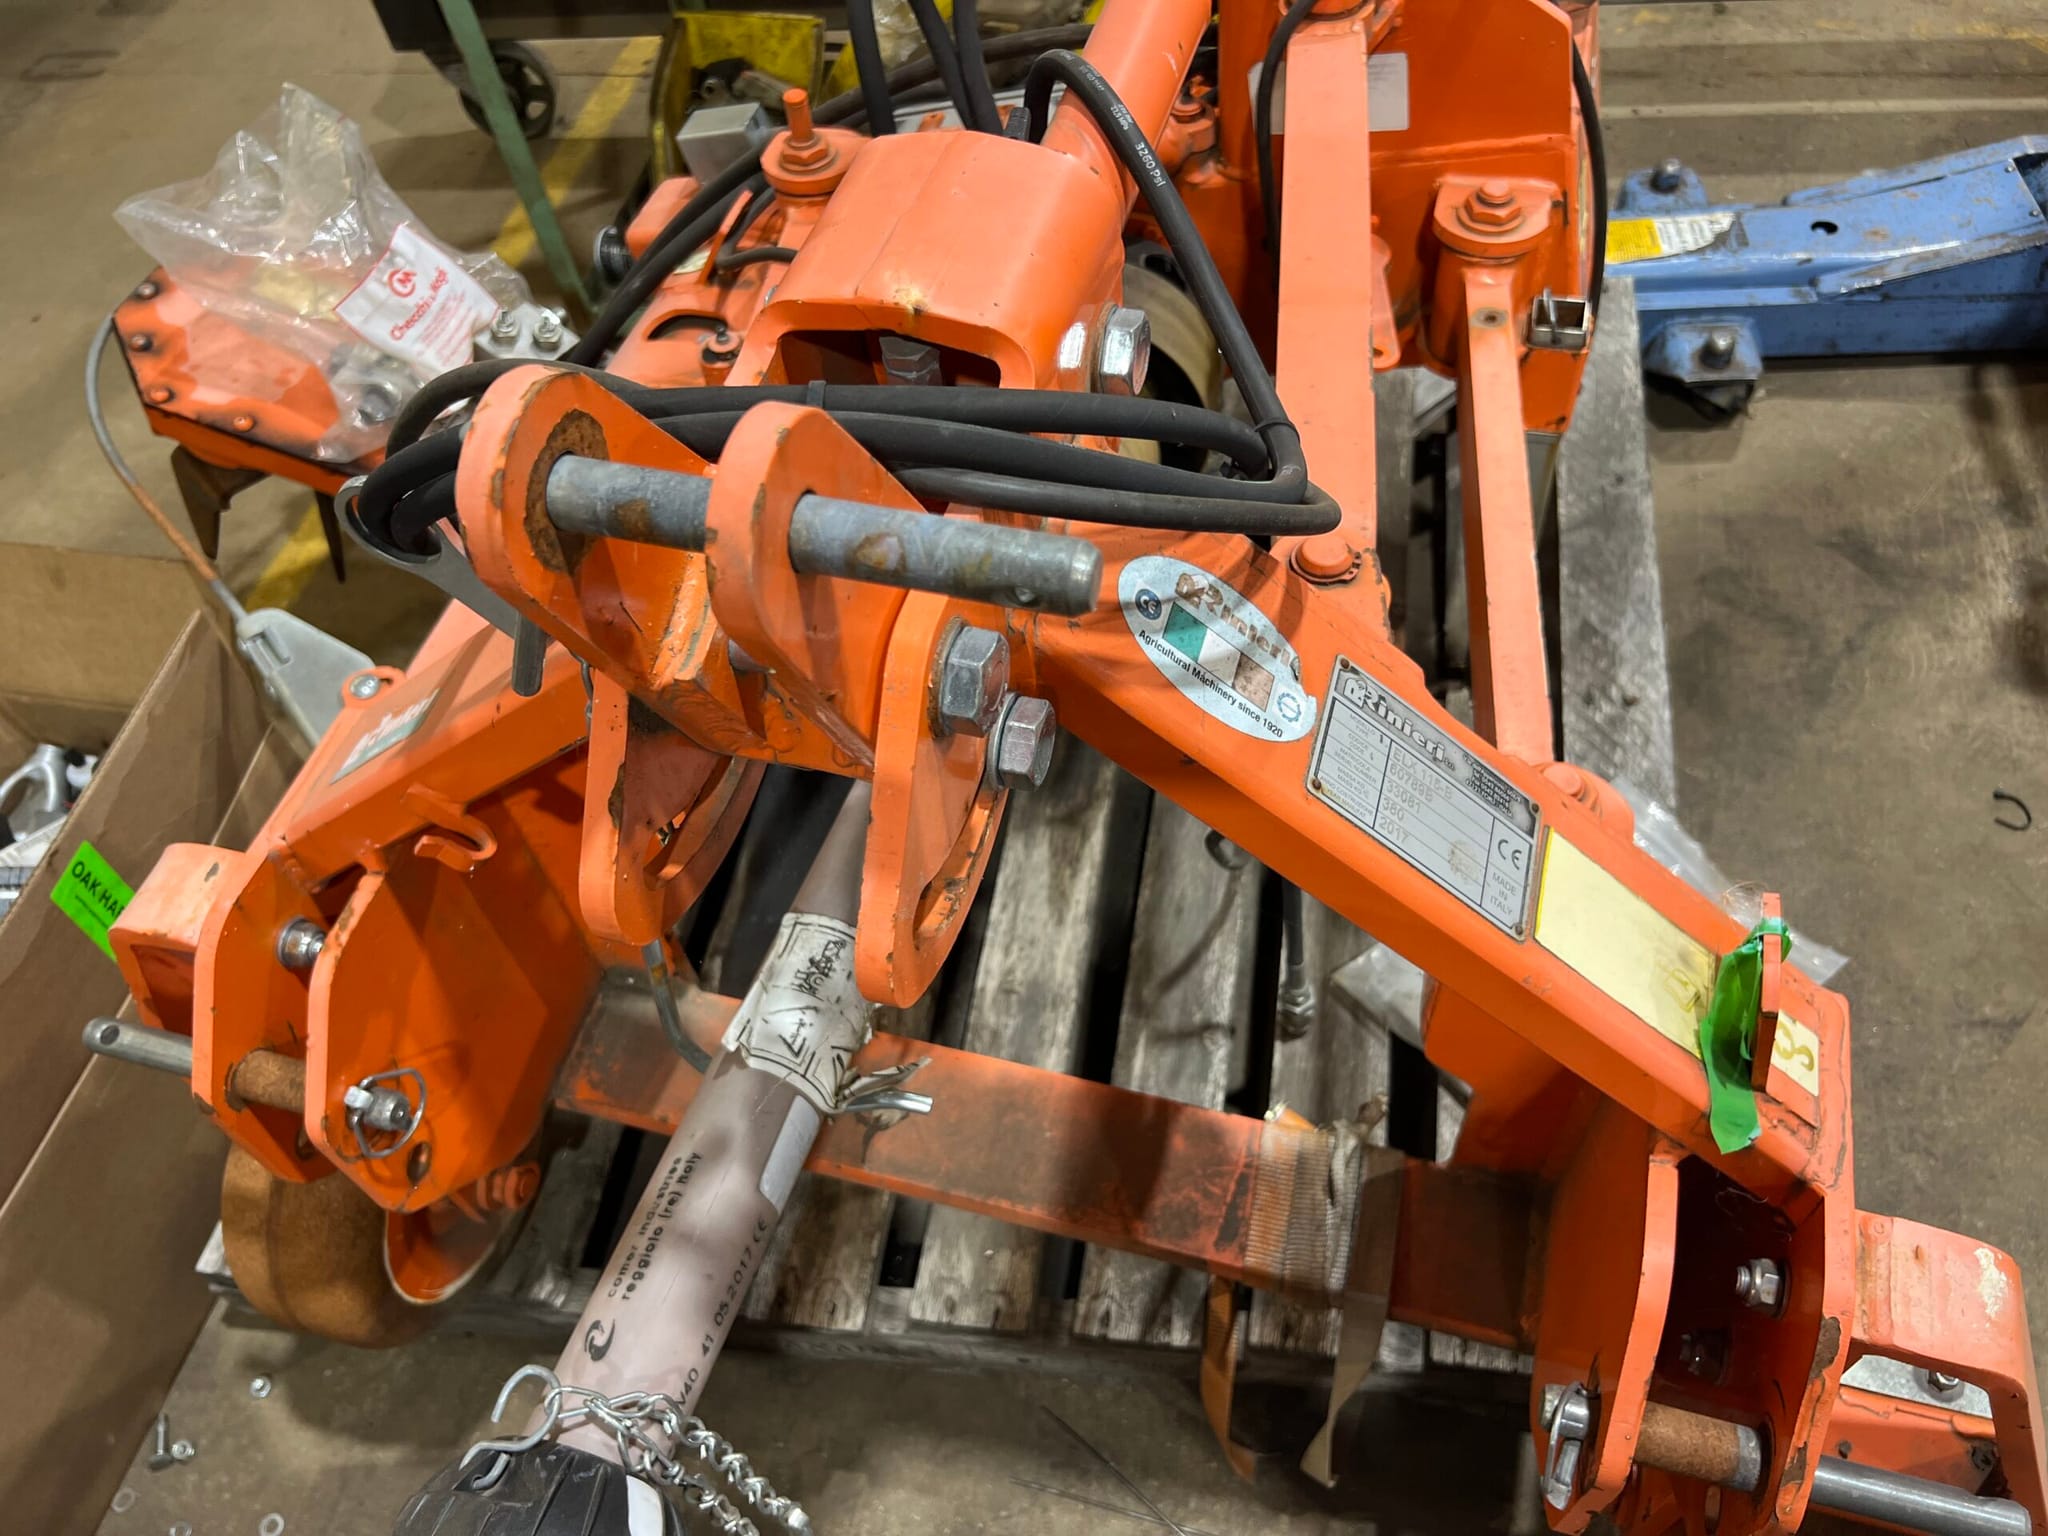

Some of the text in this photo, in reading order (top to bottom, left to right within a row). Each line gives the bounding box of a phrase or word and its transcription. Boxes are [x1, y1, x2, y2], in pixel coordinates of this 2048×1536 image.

[1134, 141, 1156, 169] 3260
[1139, 629, 1284, 738] Agricultural Machinery since 1920
[1363, 684, 1446, 763] Rinieri
[1392, 745, 1417, 774] ELX
[1381, 795, 1405, 823] 380
[1378, 814, 1409, 848] 2017
[1495, 834, 1522, 871] CE
[72, 861, 101, 896] OAK
[1492, 871, 1516, 896] MADE
[1498, 888, 1507, 901] IN
[1489, 893, 1513, 918] ITALY
[621, 1224, 663, 1302] reggiolo
[657, 1190, 683, 1217] (re)
[606, 1245, 637, 1298] comer
[714, 1300, 729, 1327] 05
[727, 1247, 752, 1297] 2017
